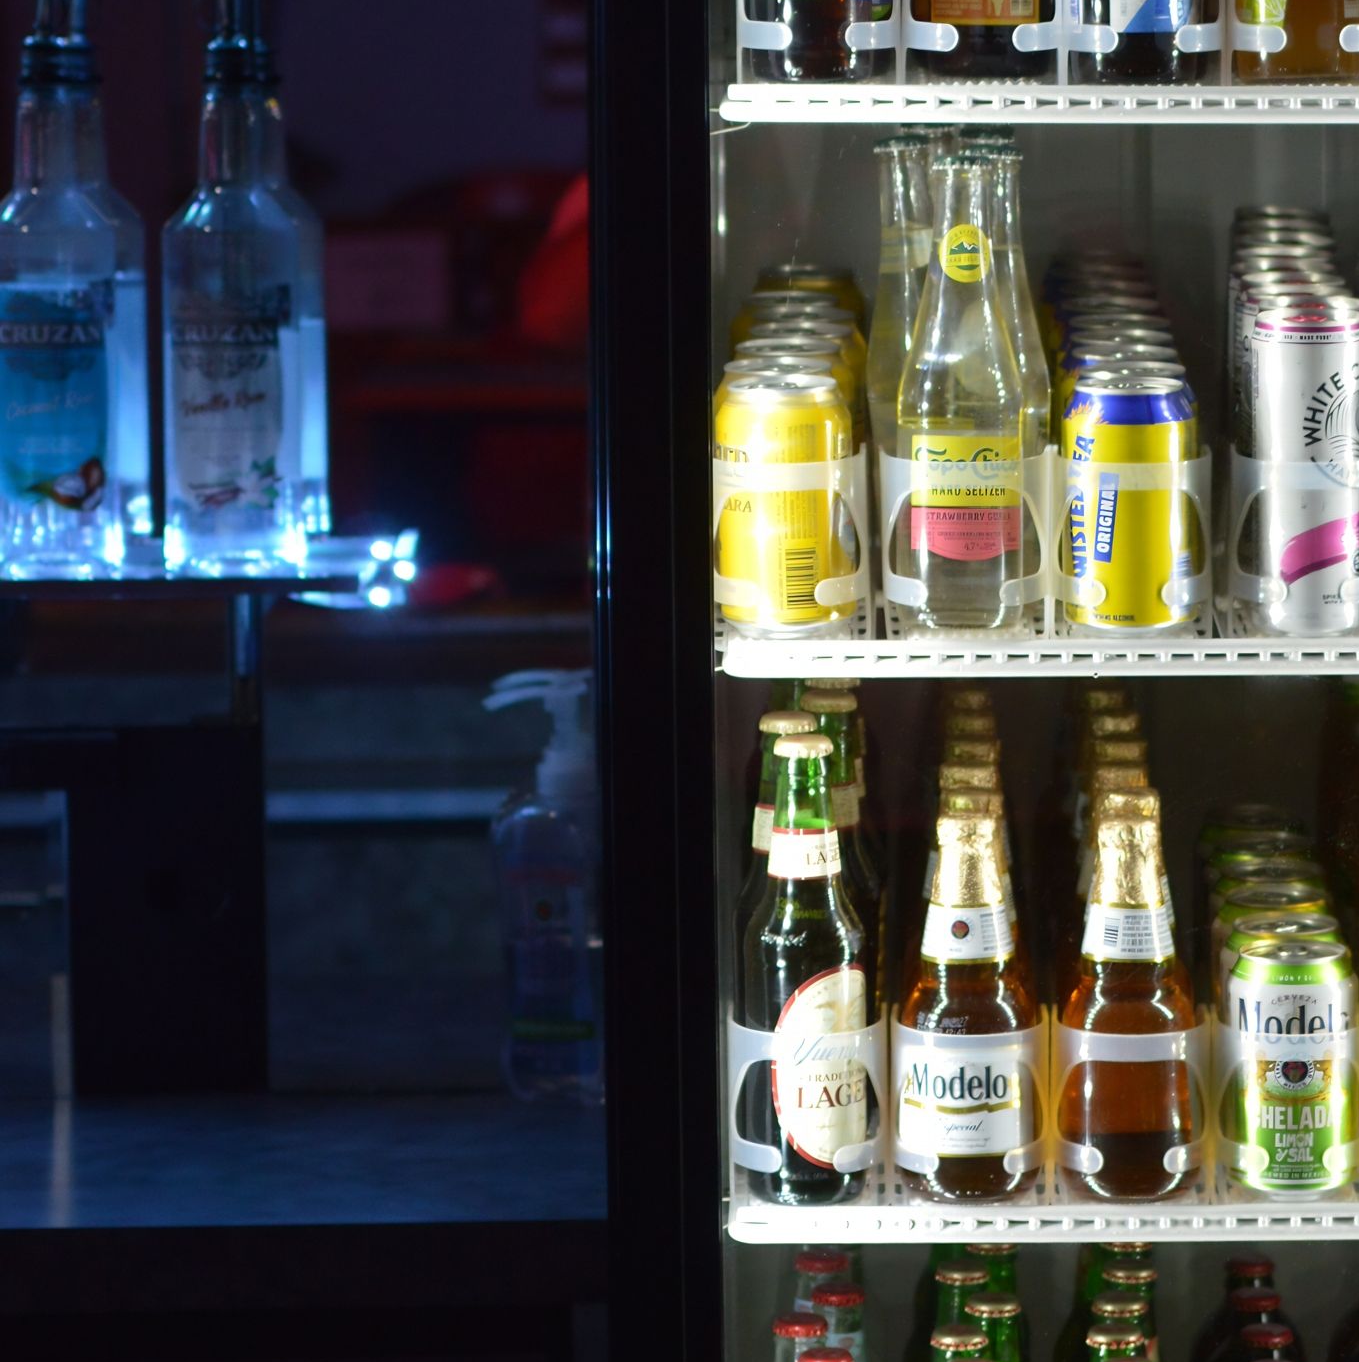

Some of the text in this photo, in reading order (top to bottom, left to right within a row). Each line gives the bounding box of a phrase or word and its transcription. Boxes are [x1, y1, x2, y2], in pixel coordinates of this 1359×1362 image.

[1302, 371, 1345, 448] WHITE
[931, 484, 1007, 497] HARD SELTZER
[1271, 993, 1319, 1006] CERVEZA
[911, 1062, 1008, 1100] Modelo
[1287, 1148, 1314, 1163] SAL
